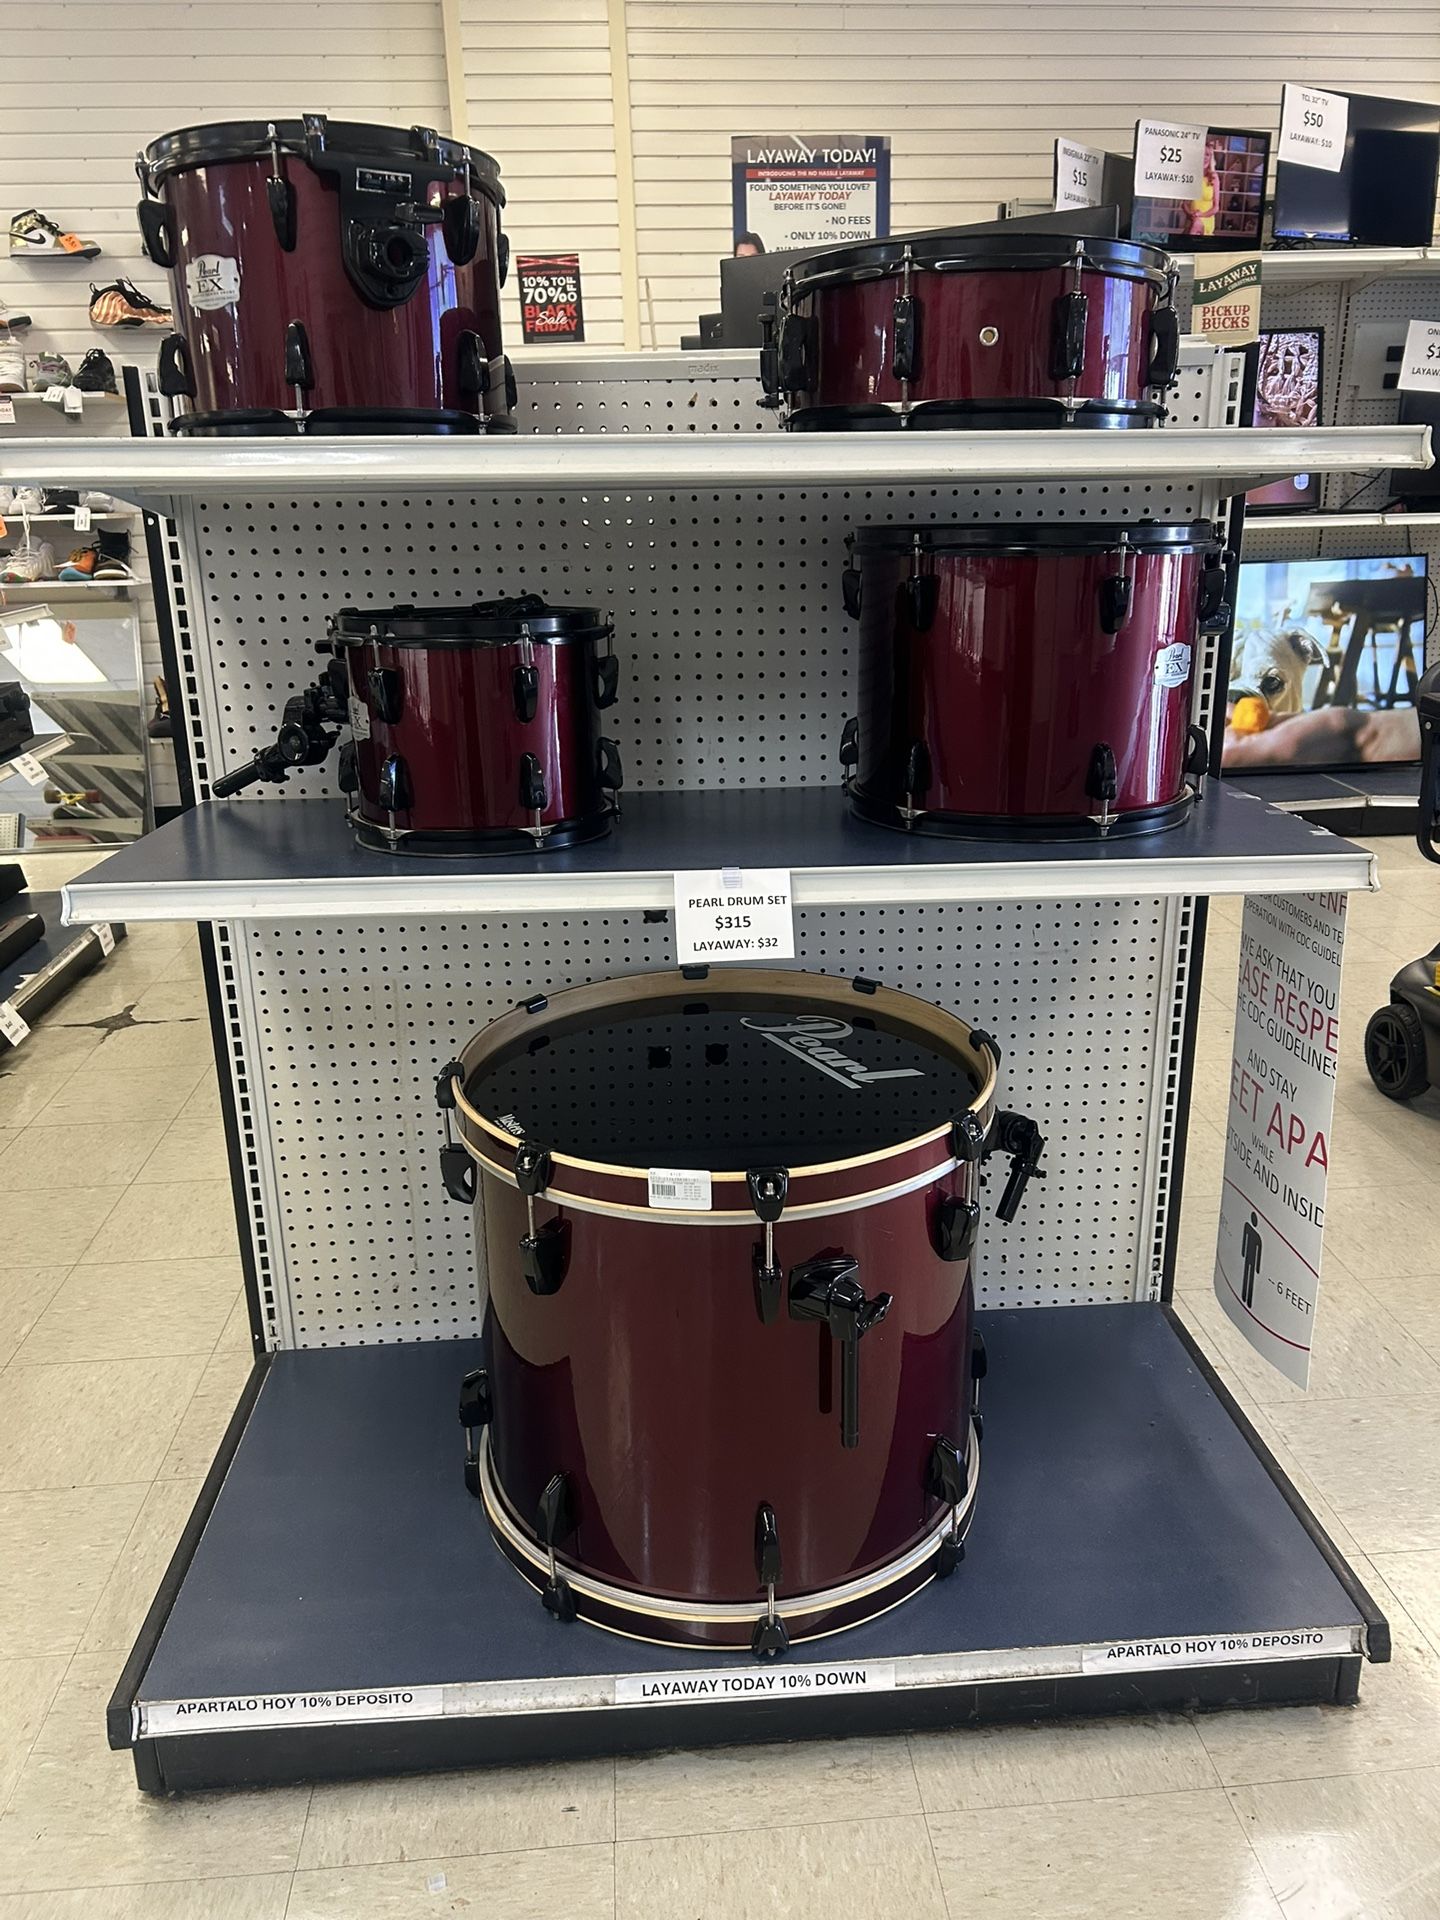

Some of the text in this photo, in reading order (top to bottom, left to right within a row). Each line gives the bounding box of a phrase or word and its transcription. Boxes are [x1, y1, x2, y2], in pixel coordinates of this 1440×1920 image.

[1304, 110, 1324, 128] $50
[1145, 128, 1180, 138] PANASONIC
[1290, 132, 1320, 145] LAYAWAY:
[747, 148, 876, 163] LAYAWAY TODAY!
[1160, 144, 1182, 163] $25
[1073, 168, 1088, 186] $15
[1145, 172, 1194, 183] LAYAWAY: $10
[769, 192, 852, 200] LAYAWAY TODAY
[822, 202, 846, 210] GONE!
[832, 216, 870, 224] NO FEES
[790, 230, 870, 240] ONLY 10% DOWN
[522, 276, 566, 287] 10% TO
[1200, 264, 1257, 292] LAYAWAY
[523, 287, 567, 304] 70%
[566, 276, 578, 302] OFF
[524, 304, 577, 318] BLACK
[536, 310, 568, 326] Sale
[1202, 304, 1250, 318] PICKUP
[526, 318, 578, 332] FRIDAY
[1202, 316, 1250, 330] BUCKS
[1412, 366, 1440, 376] LAYAW
[688, 896, 788, 908] PEARL DRUM SET
[715, 915, 752, 932] $315
[1274, 894, 1312, 928] CUSTOMERS
[1313, 920, 1330, 937] AND
[1332, 928, 1344, 944] TE
[1278, 920, 1296, 940] WITH
[1296, 932, 1310, 950] CDC
[693, 937, 778, 952] LAYAWAY: $32
[1256, 944, 1274, 972] ASK
[1276, 957, 1304, 992] THAT
[1307, 978, 1336, 1010] YOU
[1239, 953, 1338, 1054] ASE RESPE
[1248, 1000, 1266, 1030] CDC
[740, 1015, 926, 1085] Pearl
[1247, 1049, 1298, 1102] AND STAY
[1266, 1102, 1328, 1175] APA
[1252, 1132, 1274, 1164] WHILE
[1227, 1127, 1252, 1170] TSIDE
[1253, 1160, 1279, 1195] AND
[1276, 1282, 1312, 1316] 6 FEET
[1107, 1633, 1324, 1658] APARTALO HOY 10% DEPOSITO
[642, 1670, 867, 1697] LAYAWAY TODAY 10% DOWN
[176, 1692, 414, 1716] APARTALO HOY 10% DEPOSITO
